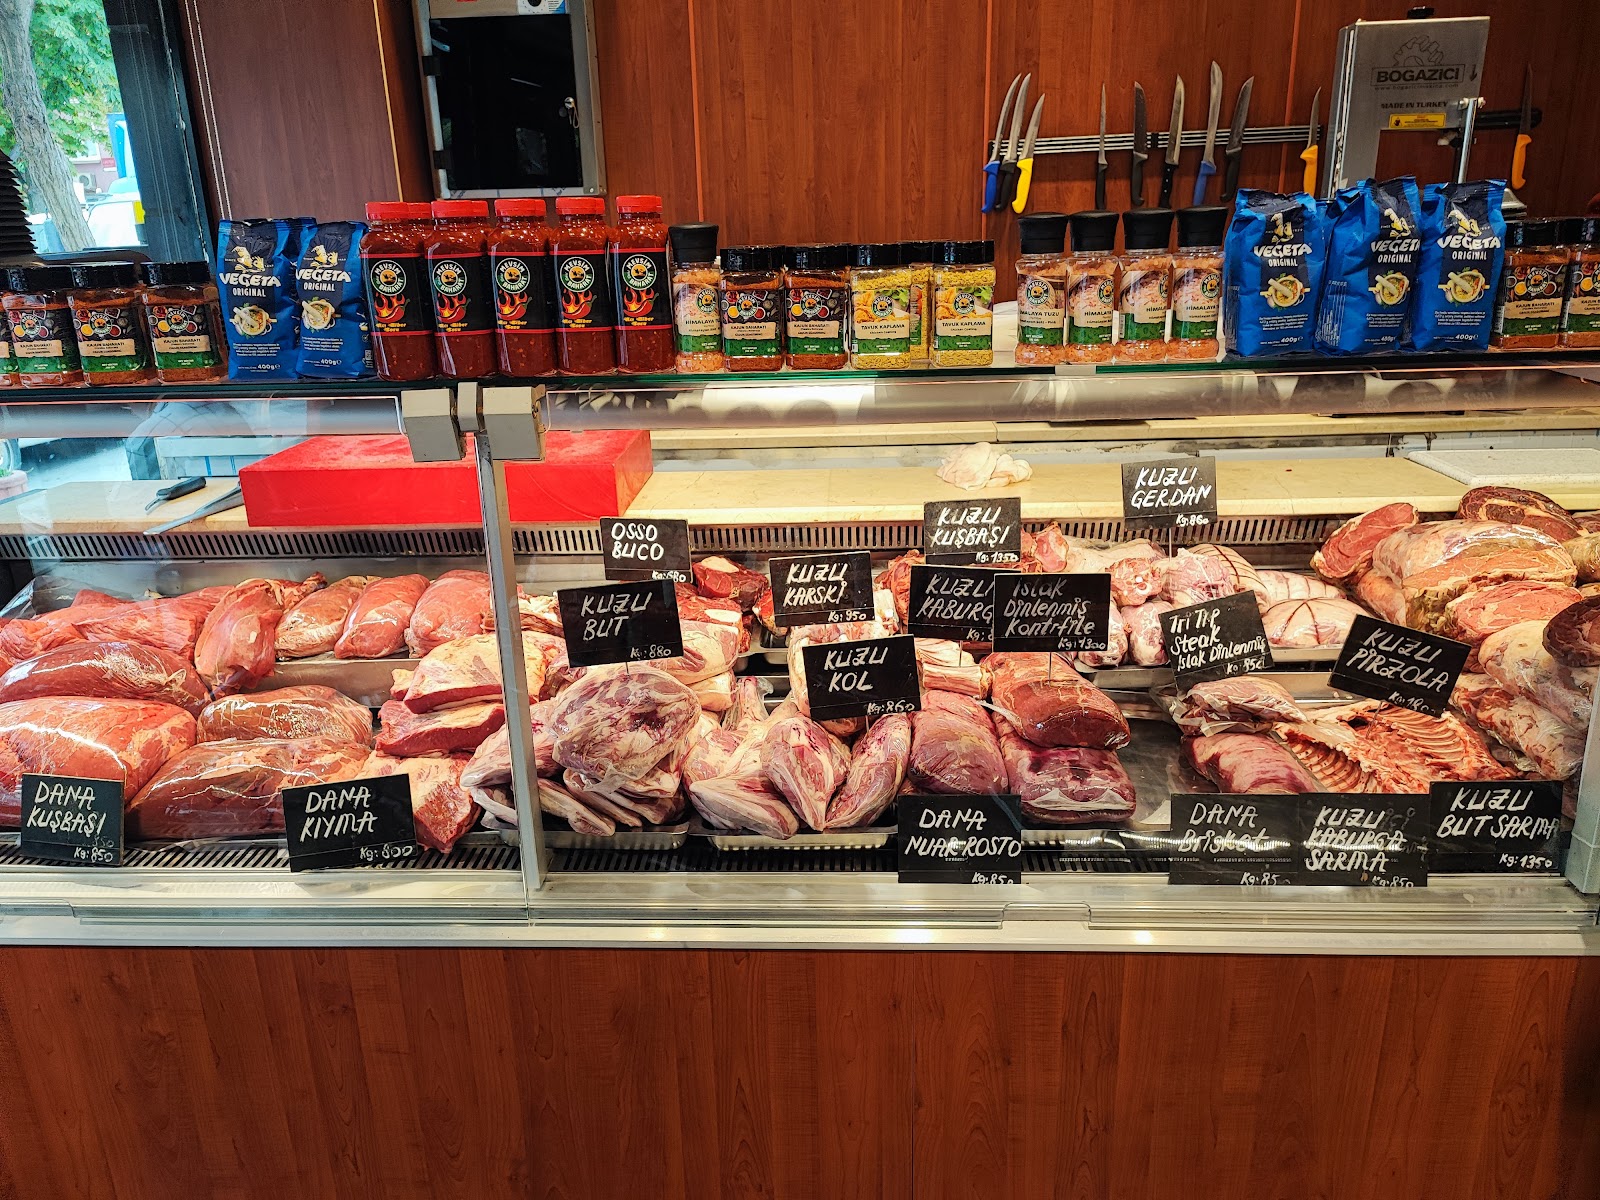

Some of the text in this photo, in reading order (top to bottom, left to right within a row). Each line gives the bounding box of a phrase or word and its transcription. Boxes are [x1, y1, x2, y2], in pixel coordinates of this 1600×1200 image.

[1254, 243, 1312, 258] VEGETA
[1437, 236, 1501, 250] VEGETA
[1452, 250, 1486, 260] ORIGINAL
[1268, 259, 1298, 267] ORIGINAL
[1378, 254, 1412, 263] ORIGINAL
[219, 272, 281, 287] VEGETA
[304, 282, 335, 292] ORIGINAL
[232, 288, 266, 298] ORIGINAL
[1134, 466, 1198, 490] KUZU
[1130, 484, 1212, 510] GERDAN
[937, 506, 1002, 526] KUZU
[611, 522, 658, 541] OSSO
[930, 525, 1010, 548] KUŞBAŞI
[612, 541, 664, 560] BUCO
[786, 562, 848, 584] KUZU
[580, 592, 653, 617] KUZU
[916, 596, 994, 624] KABURG
[582, 616, 630, 641] BUT
[1170, 624, 1221, 656] Steak
[1363, 627, 1443, 664] KUZU
[824, 646, 889, 671] KUZU
[828, 670, 874, 693] KOL
[34, 781, 96, 810] DANA
[304, 786, 372, 814] DANA
[1450, 786, 1534, 812] KUZU
[26, 805, 106, 838] KUŞBAŞI
[300, 811, 378, 843] KIYMA
[918, 808, 988, 832] DANA
[1189, 802, 1258, 828] DANA
[1314, 805, 1386, 829] KUZU
[1436, 814, 1560, 840] BUT SARMA
[904, 835, 1022, 858] NUAR ROSTO
[1305, 827, 1408, 852] KABURGA
[1305, 848, 1390, 872] SARMA
